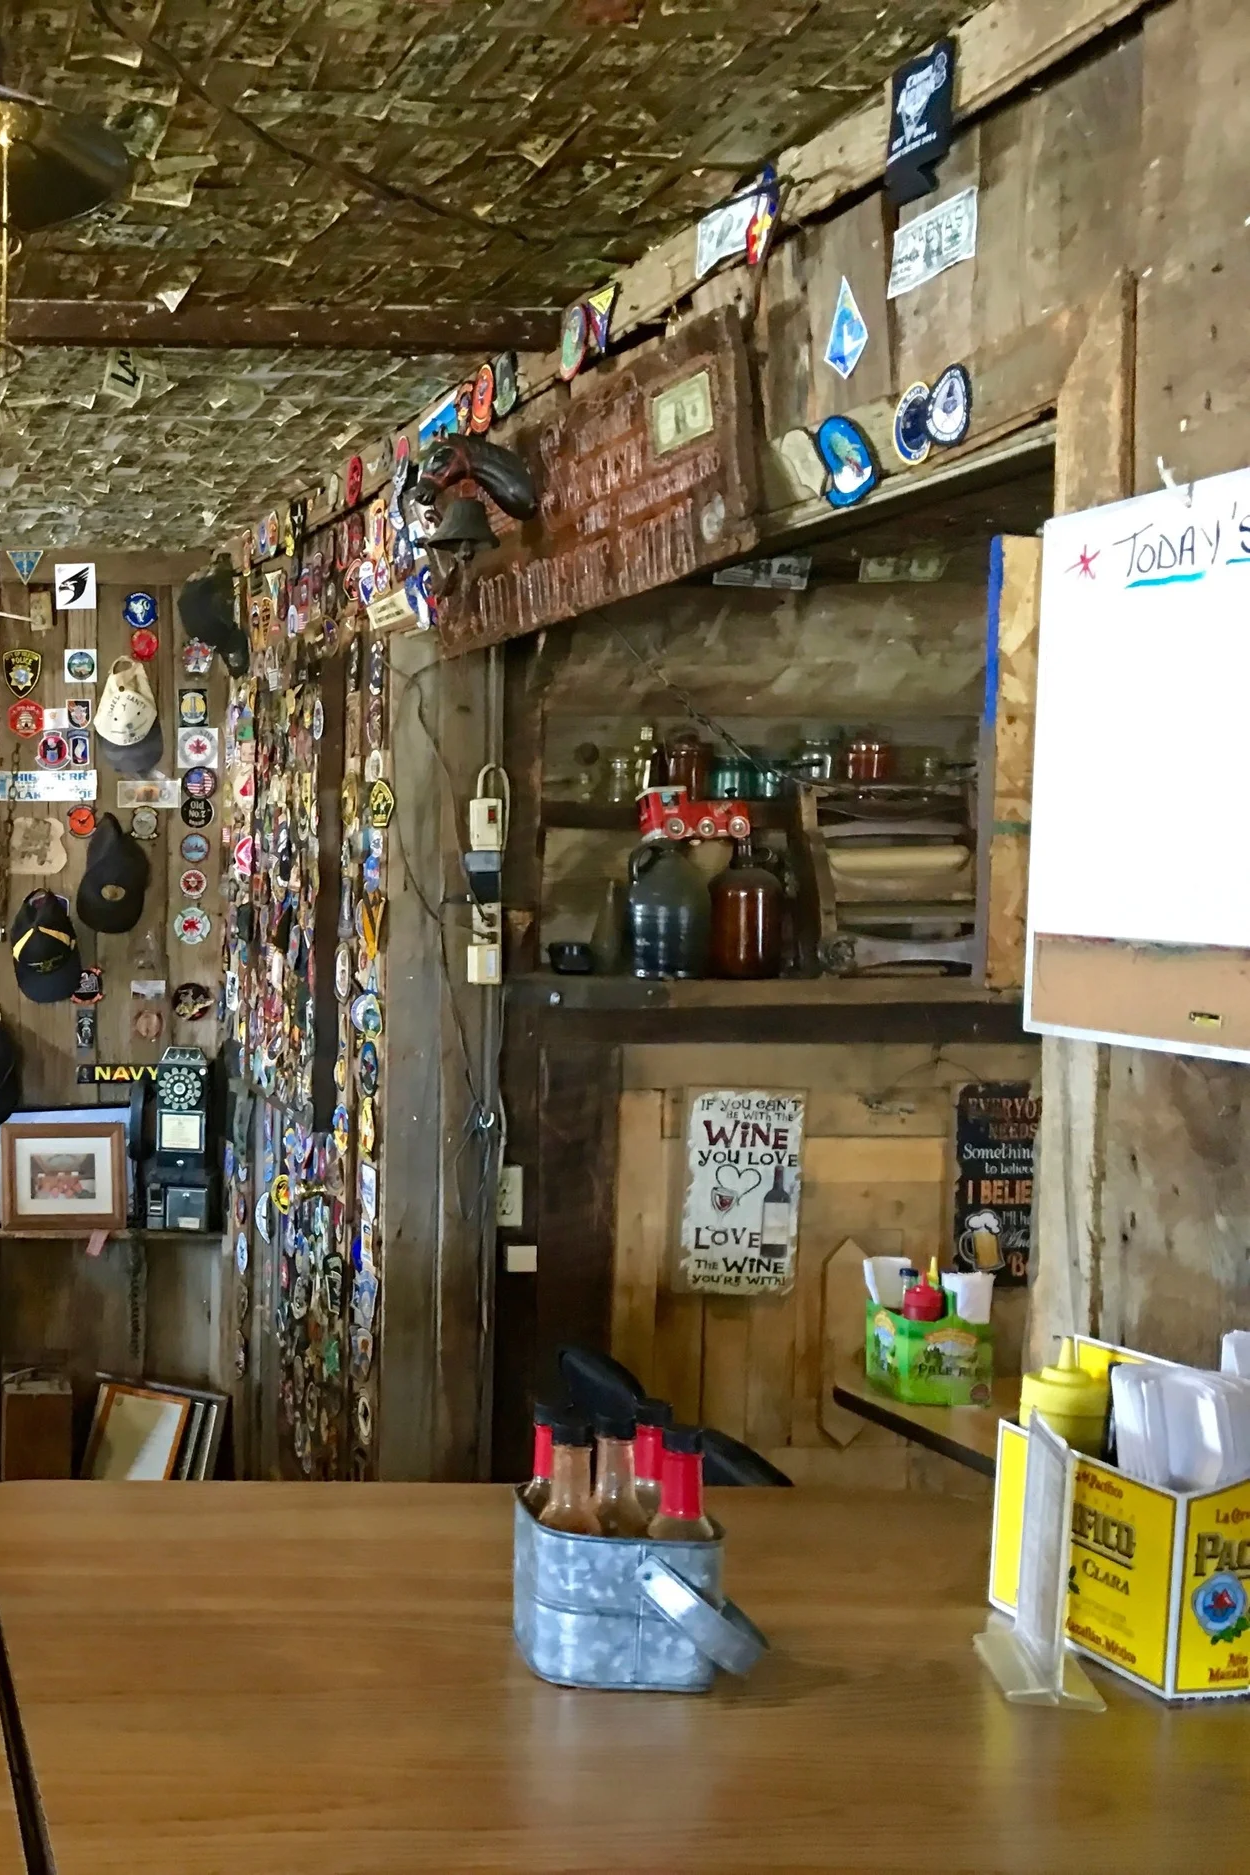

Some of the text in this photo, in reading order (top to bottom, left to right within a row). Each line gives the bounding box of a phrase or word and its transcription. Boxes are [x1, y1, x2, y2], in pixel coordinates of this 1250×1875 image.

[1112, 501, 1250, 577] TODAY'S
[190, 800, 205, 809] Old
[94, 1066, 159, 1080] NAVY
[701, 1099, 715, 1111] IF
[968, 1098, 1042, 1119] EVERYO
[748, 1151, 798, 1167] LOVE
[963, 1143, 1034, 1160] Somethin
[984, 1161, 997, 1175] to
[694, 1227, 761, 1249] LOVE
[1082, 1558, 1130, 1595] CLARA
